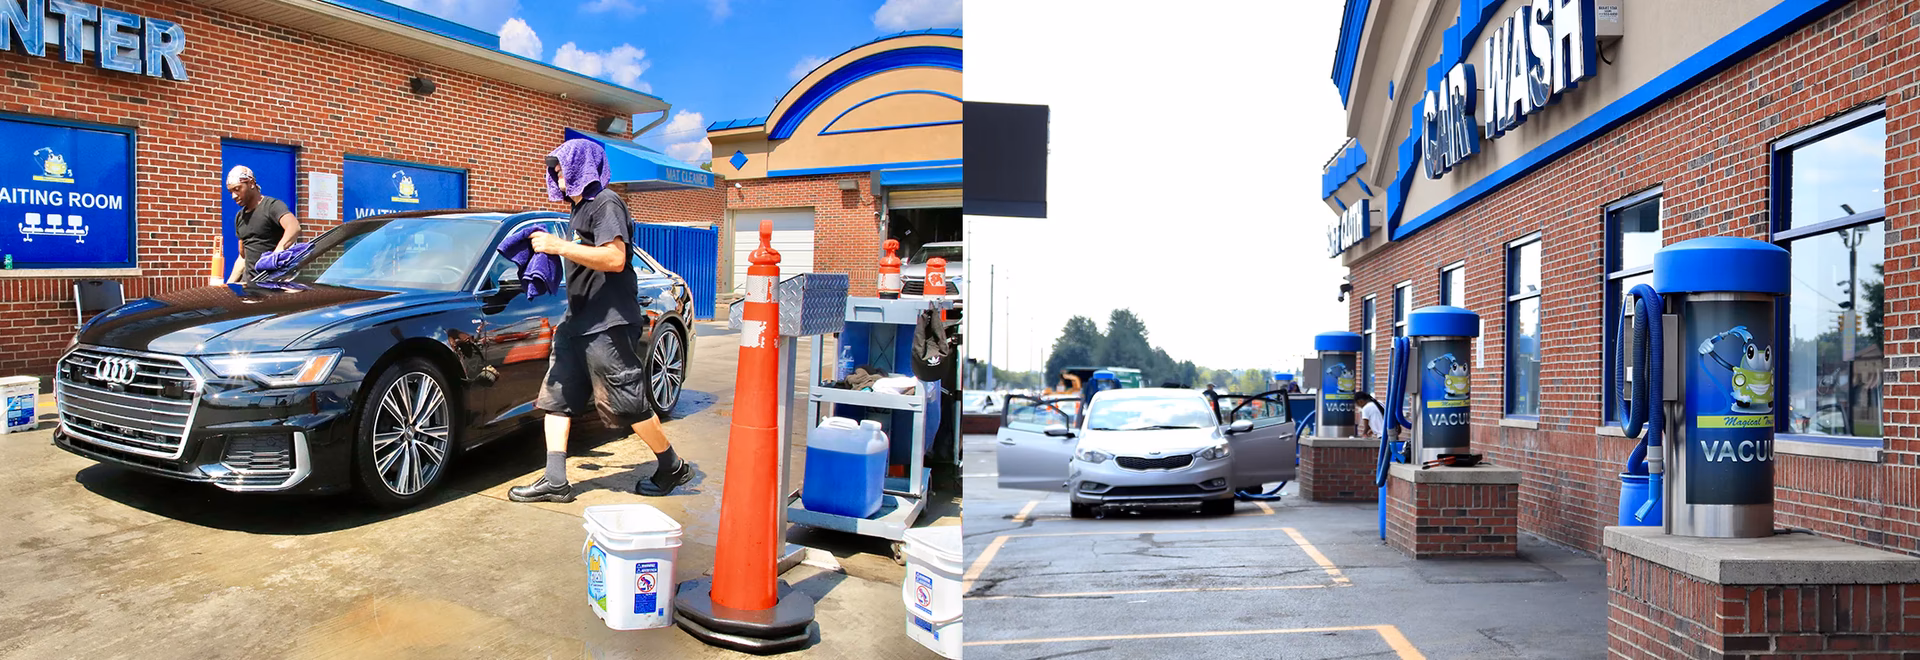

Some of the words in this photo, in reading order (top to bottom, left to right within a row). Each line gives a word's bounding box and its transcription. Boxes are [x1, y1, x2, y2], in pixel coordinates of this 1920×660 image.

[0, 0, 189, 81] NTER
[1422, 62, 1478, 181] CAR
[1484, 0, 1594, 140] WASH
[666, 167, 681, 182] MAT
[682, 170, 708, 186] CLEANER
[0, 187, 63, 207] AITING
[68, 191, 123, 210] ROOM
[1724, 416, 1762, 428] Magical
